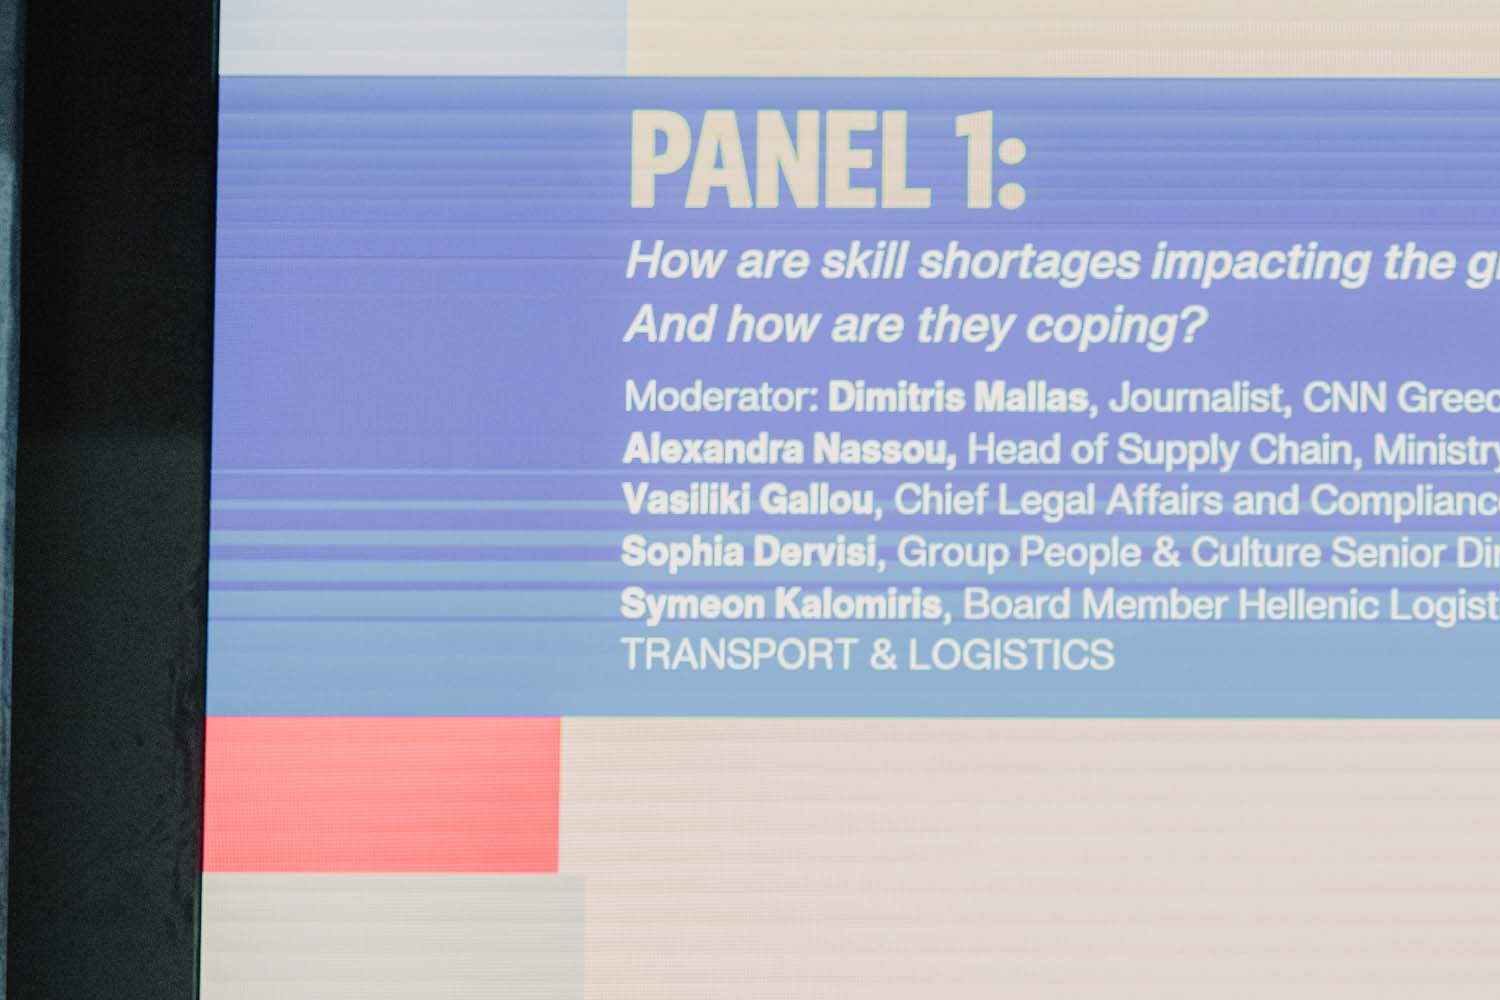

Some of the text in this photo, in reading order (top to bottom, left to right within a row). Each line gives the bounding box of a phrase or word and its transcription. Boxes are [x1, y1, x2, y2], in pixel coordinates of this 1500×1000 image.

[631, 110, 1026, 209] PANEL 1:
[626, 239, 728, 279] How
[737, 249, 810, 279] are
[821, 240, 910, 279] skill
[918, 241, 1141, 289] shortages
[1152, 241, 1372, 289] impacting
[1385, 242, 1456, 280] the
[623, 303, 1208, 353] And how are they coping?
[625, 379, 818, 412] Moderator:
[829, 380, 966, 412] Dimitris
[975, 380, 1098, 418] Mallas,
[1109, 381, 1292, 418] Journalist,
[1304, 381, 1386, 413] CNN
[622, 431, 804, 464] Alexandra
[813, 431, 957, 471] Nassou,
[969, 431, 1061, 465] Head
[1071, 432, 1108, 465] of
[1118, 433, 1241, 473] Supply
[1250, 433, 1362, 470] Chain,
[622, 481, 751, 515] Vasiliki
[760, 482, 882, 521] Gallou,
[895, 482, 988, 515] Chief
[999, 483, 1095, 523] Legal
[1106, 483, 1223, 515] Affairs
[1233, 483, 1299, 515] and
[621, 534, 744, 575] Sophia
[754, 534, 886, 573] Dervisi,
[898, 534, 1009, 575] Group
[1021, 535, 1142, 575] People
[1153, 535, 1180, 568] &
[1192, 535, 1322, 568] Culture
[1331, 536, 1447, 568] Senior
[621, 586, 765, 627] Symeon
[775, 586, 952, 625] Kalomiris,
[964, 587, 1071, 620] Board
[1083, 587, 1229, 620] Member
[1239, 588, 1379, 620] Hellenic
[621, 637, 1115, 670] TRANSPORT & LOGISTICS
